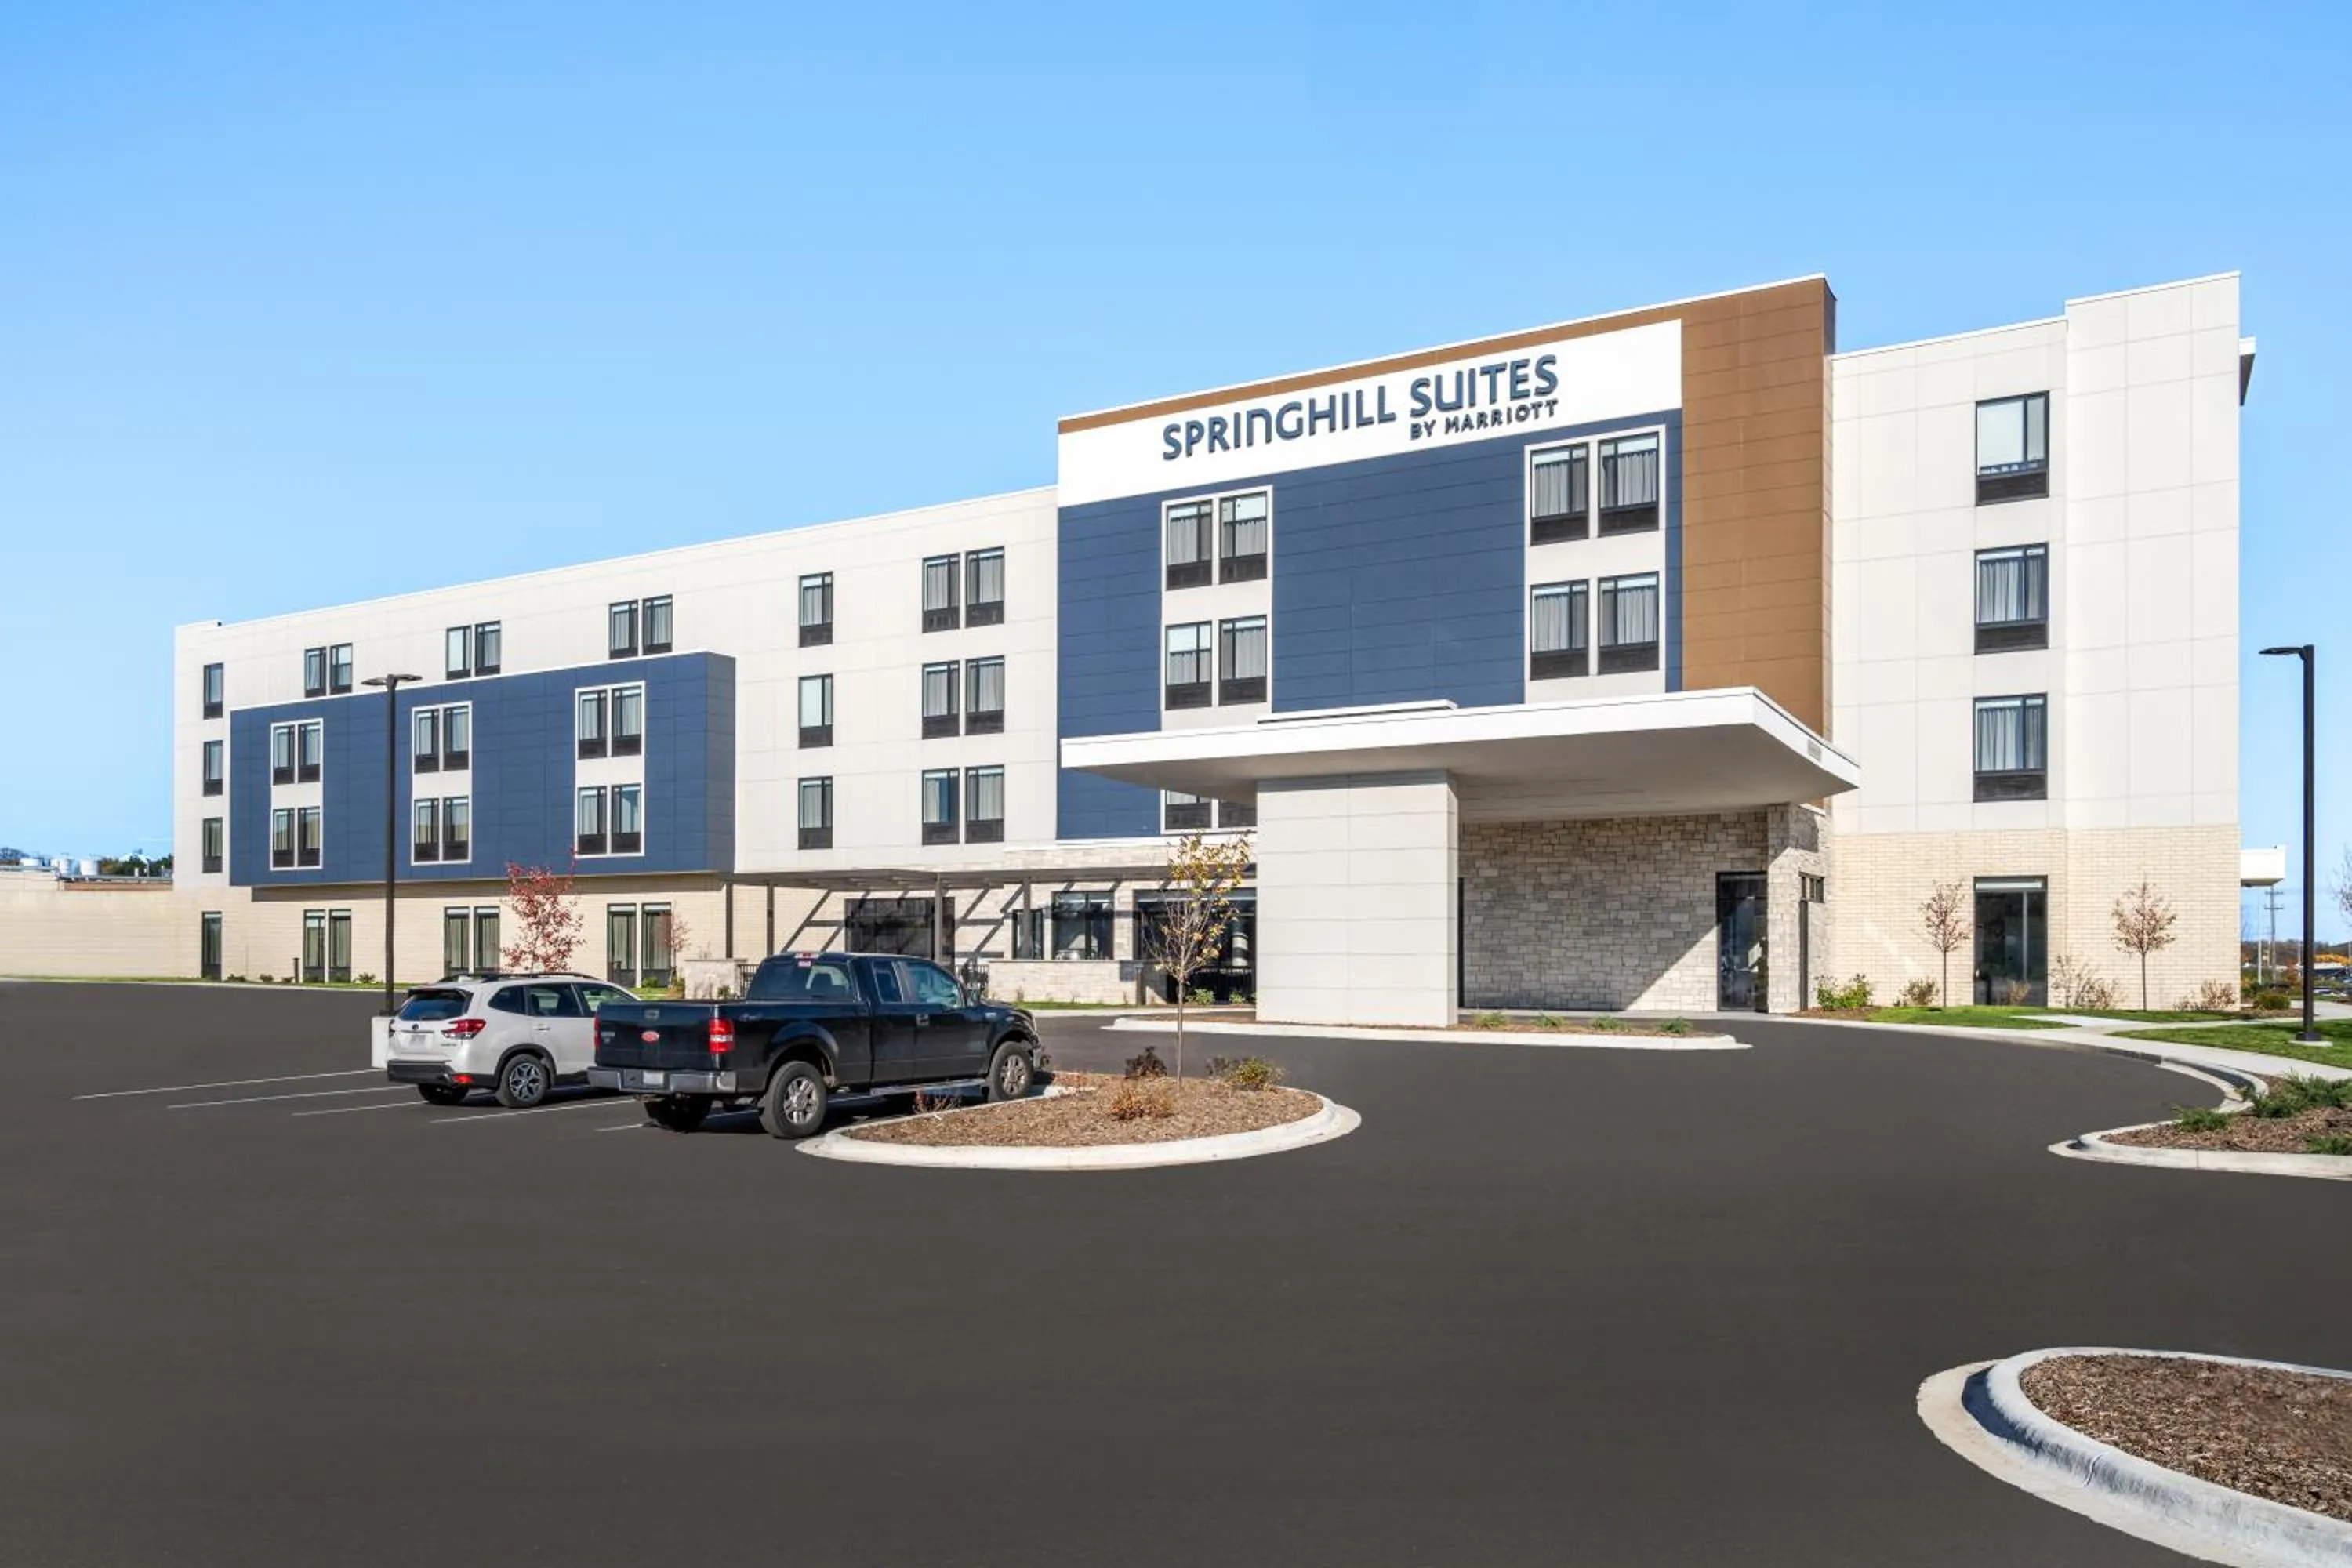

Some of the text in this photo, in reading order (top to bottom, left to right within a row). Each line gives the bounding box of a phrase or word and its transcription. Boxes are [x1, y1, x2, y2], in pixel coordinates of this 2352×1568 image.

[1163, 354, 1559, 461] SPRINGHILL SUITES
[1410, 398, 1559, 441] BY MARRIOTT
